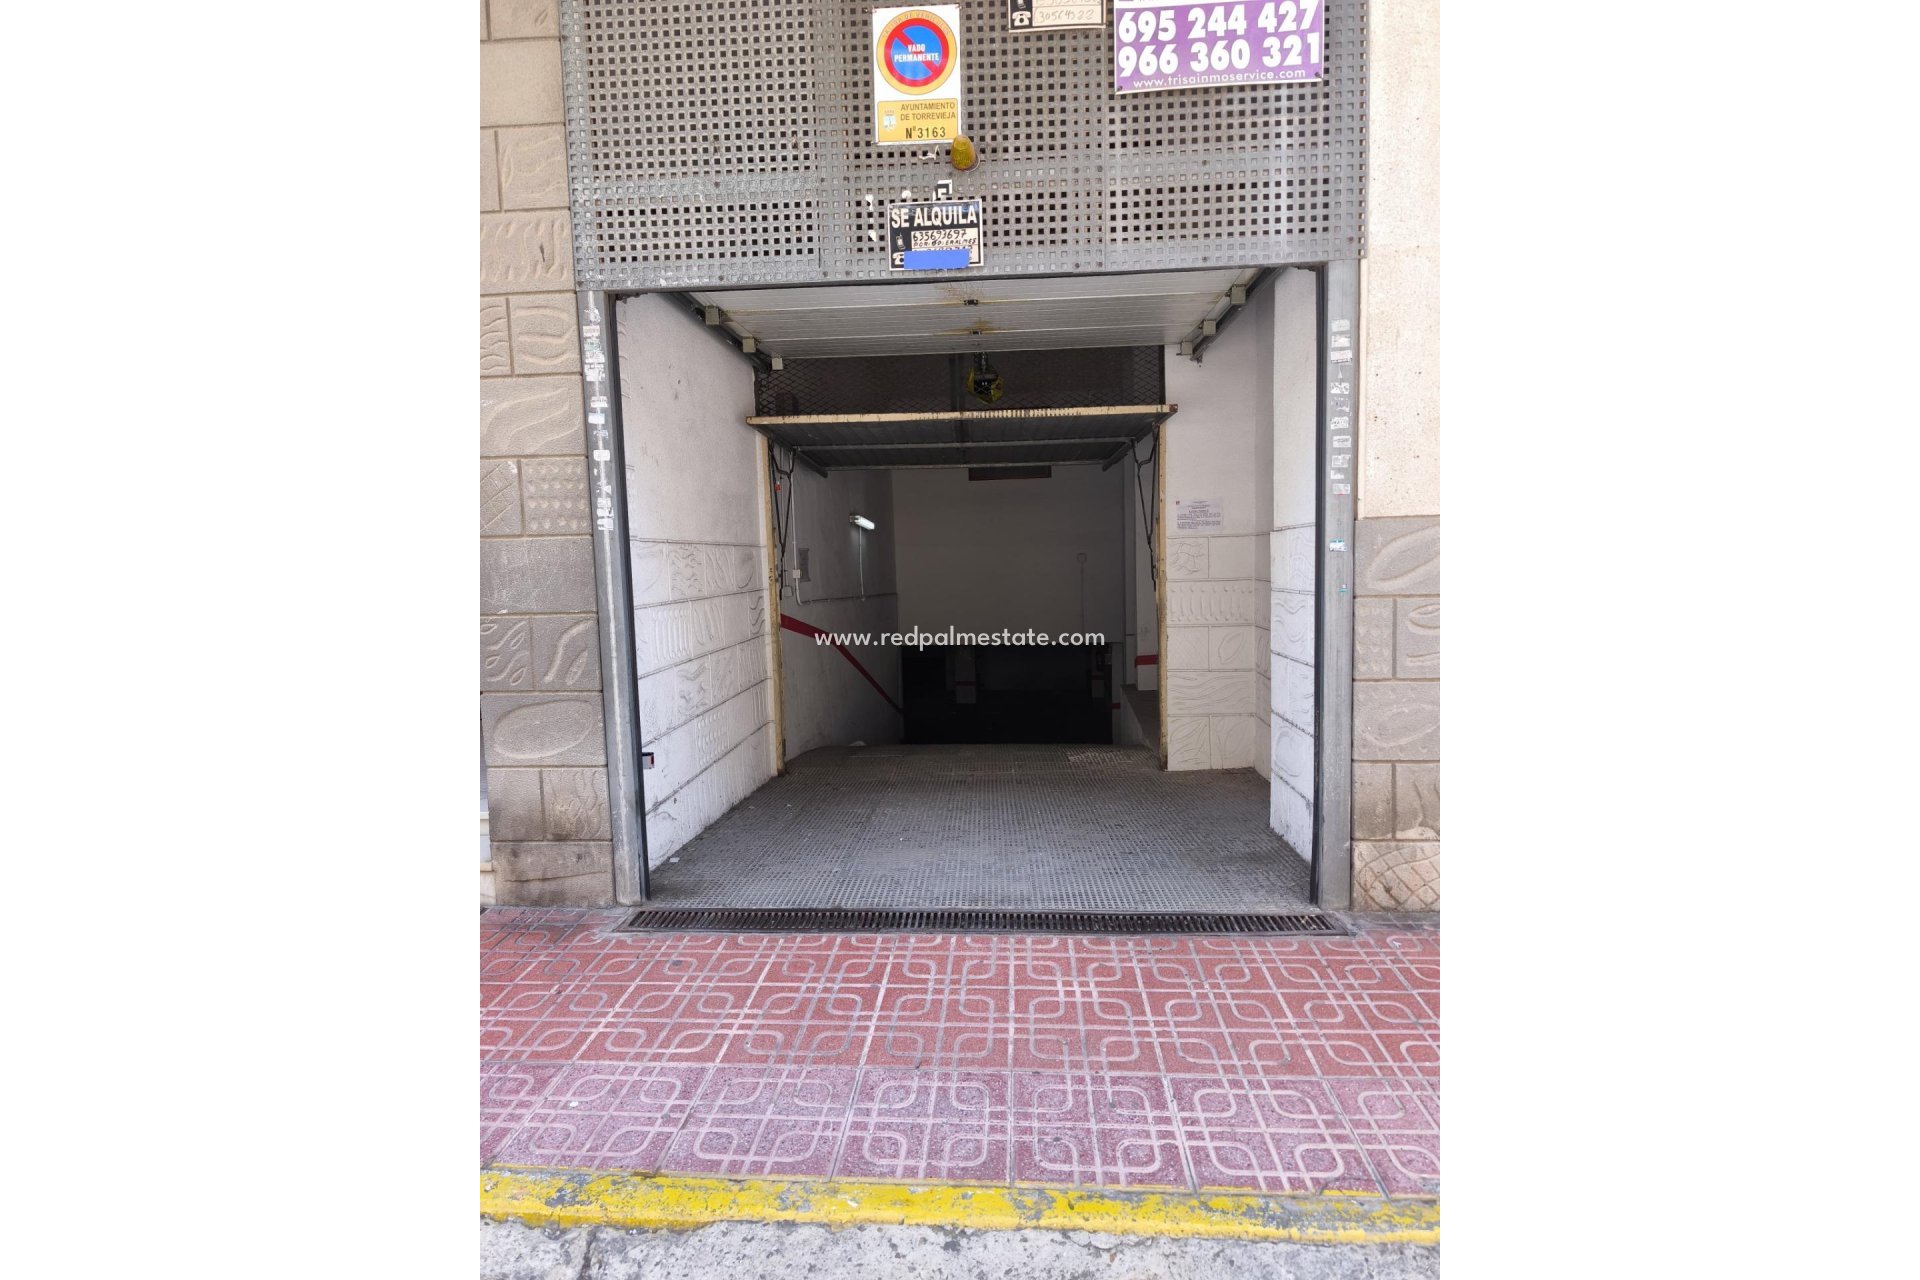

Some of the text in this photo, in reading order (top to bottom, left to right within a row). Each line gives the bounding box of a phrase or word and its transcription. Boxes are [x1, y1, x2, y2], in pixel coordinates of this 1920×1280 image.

[1118, 0, 1319, 43] 695 244 427
[907, 44, 926, 52] VADO
[1118, 32, 1320, 77] 966 360 321
[894, 53, 939, 62] PERMANENTE
[1133, 69, 1306, 88] www.trisainmoservice.com
[901, 102, 955, 111] AYUNTAMIENTO
[912, 112, 956, 121] TORREVIEJA
[891, 205, 977, 228] SE ALQUILA
